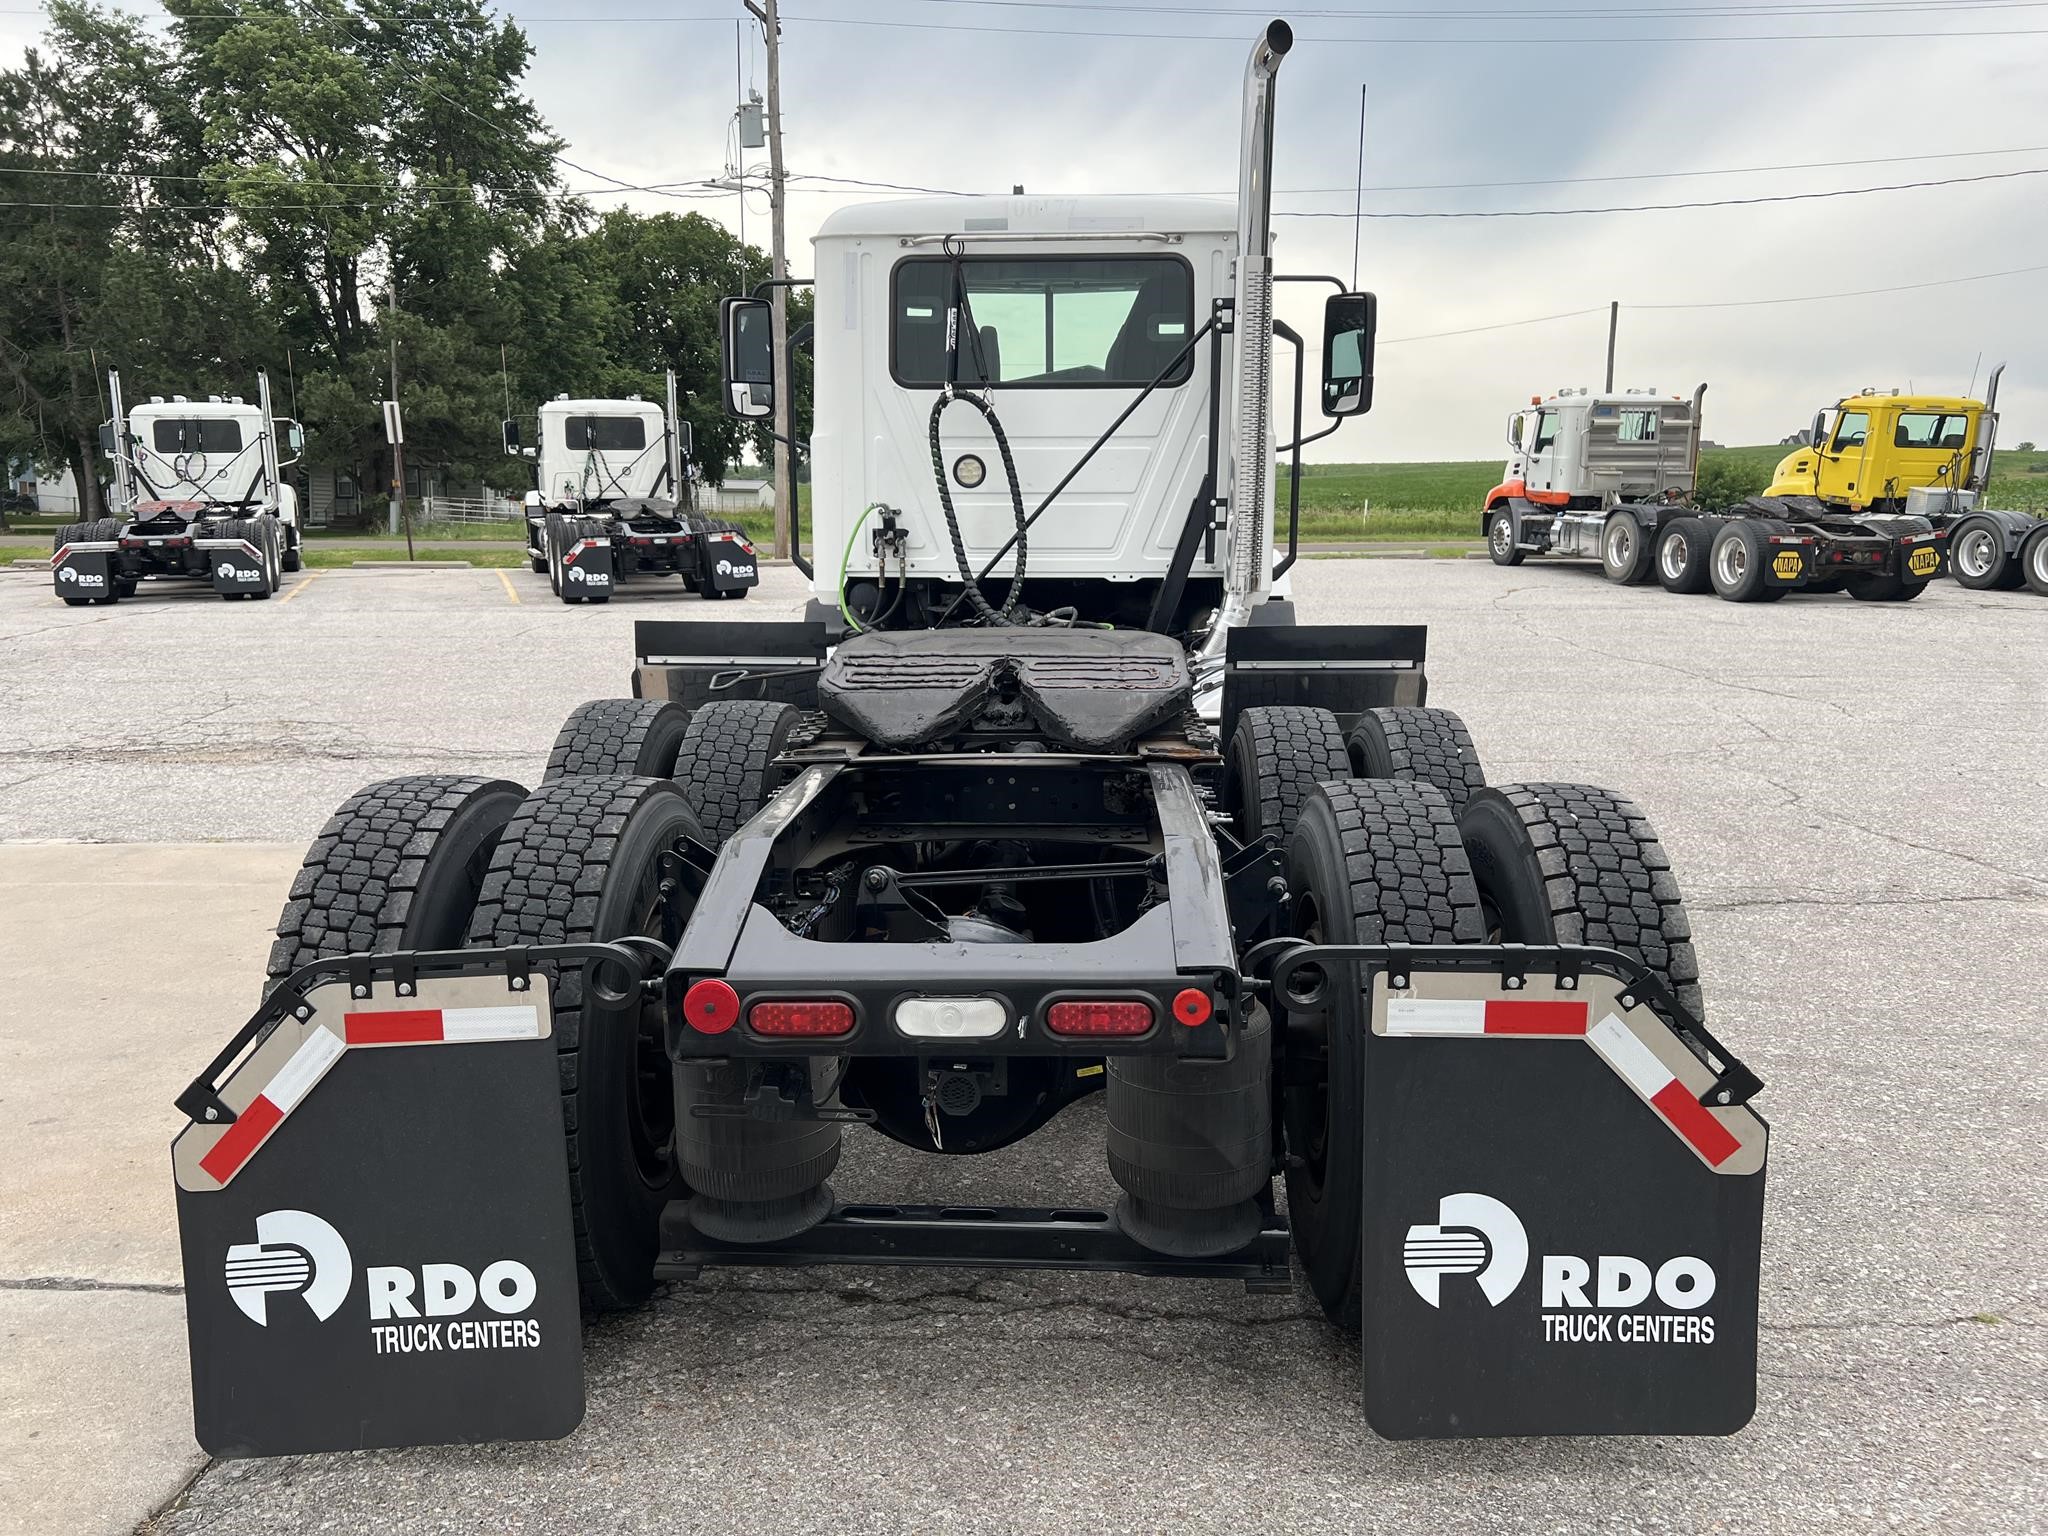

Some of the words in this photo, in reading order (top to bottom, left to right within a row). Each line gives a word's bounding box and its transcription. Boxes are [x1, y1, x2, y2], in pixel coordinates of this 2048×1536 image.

[732, 565, 754, 574] RDO
[1776, 557, 1798, 573] NAPA
[1912, 552, 1936, 571] NAPA
[78, 574, 103, 583] RDO
[236, 570, 260, 578] RDO
[585, 573, 609, 582] RDO
[366, 1259, 538, 1320] RDO
[1541, 1255, 1717, 1310] RDO
[371, 1323, 443, 1354] TRUCK
[447, 1319, 541, 1350] CENTERS
[1541, 1314, 1613, 1343] TRUCK
[1617, 1314, 1716, 1345] CENTERS
